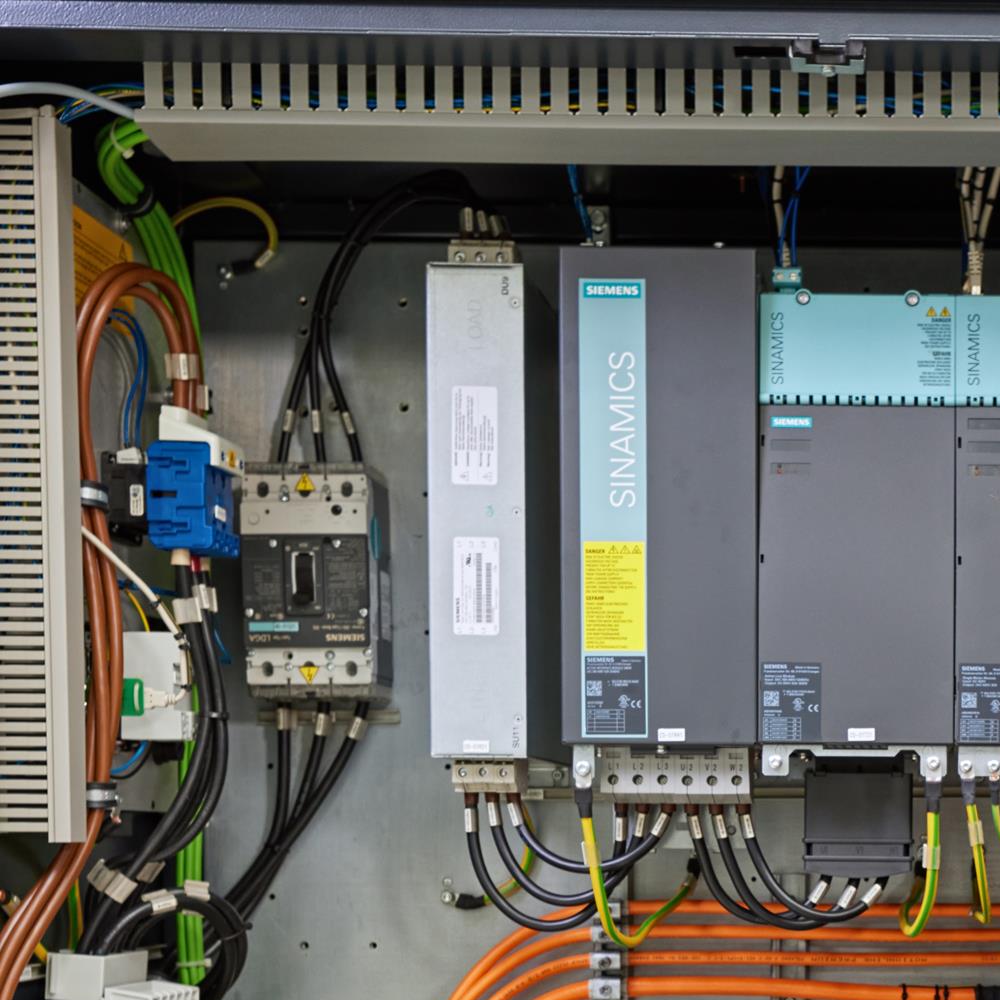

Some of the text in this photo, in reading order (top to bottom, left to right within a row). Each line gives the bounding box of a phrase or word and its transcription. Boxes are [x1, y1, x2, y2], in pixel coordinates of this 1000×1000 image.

[586, 285, 638, 296] SIEMENS
[771, 312, 784, 385] SINAMICS
[967, 313, 981, 386] SINAMICS
[608, 351, 636, 508] SINAMICS
[773, 417, 810, 426] SIEMENS
[325, 633, 365, 642] SIEMENS
